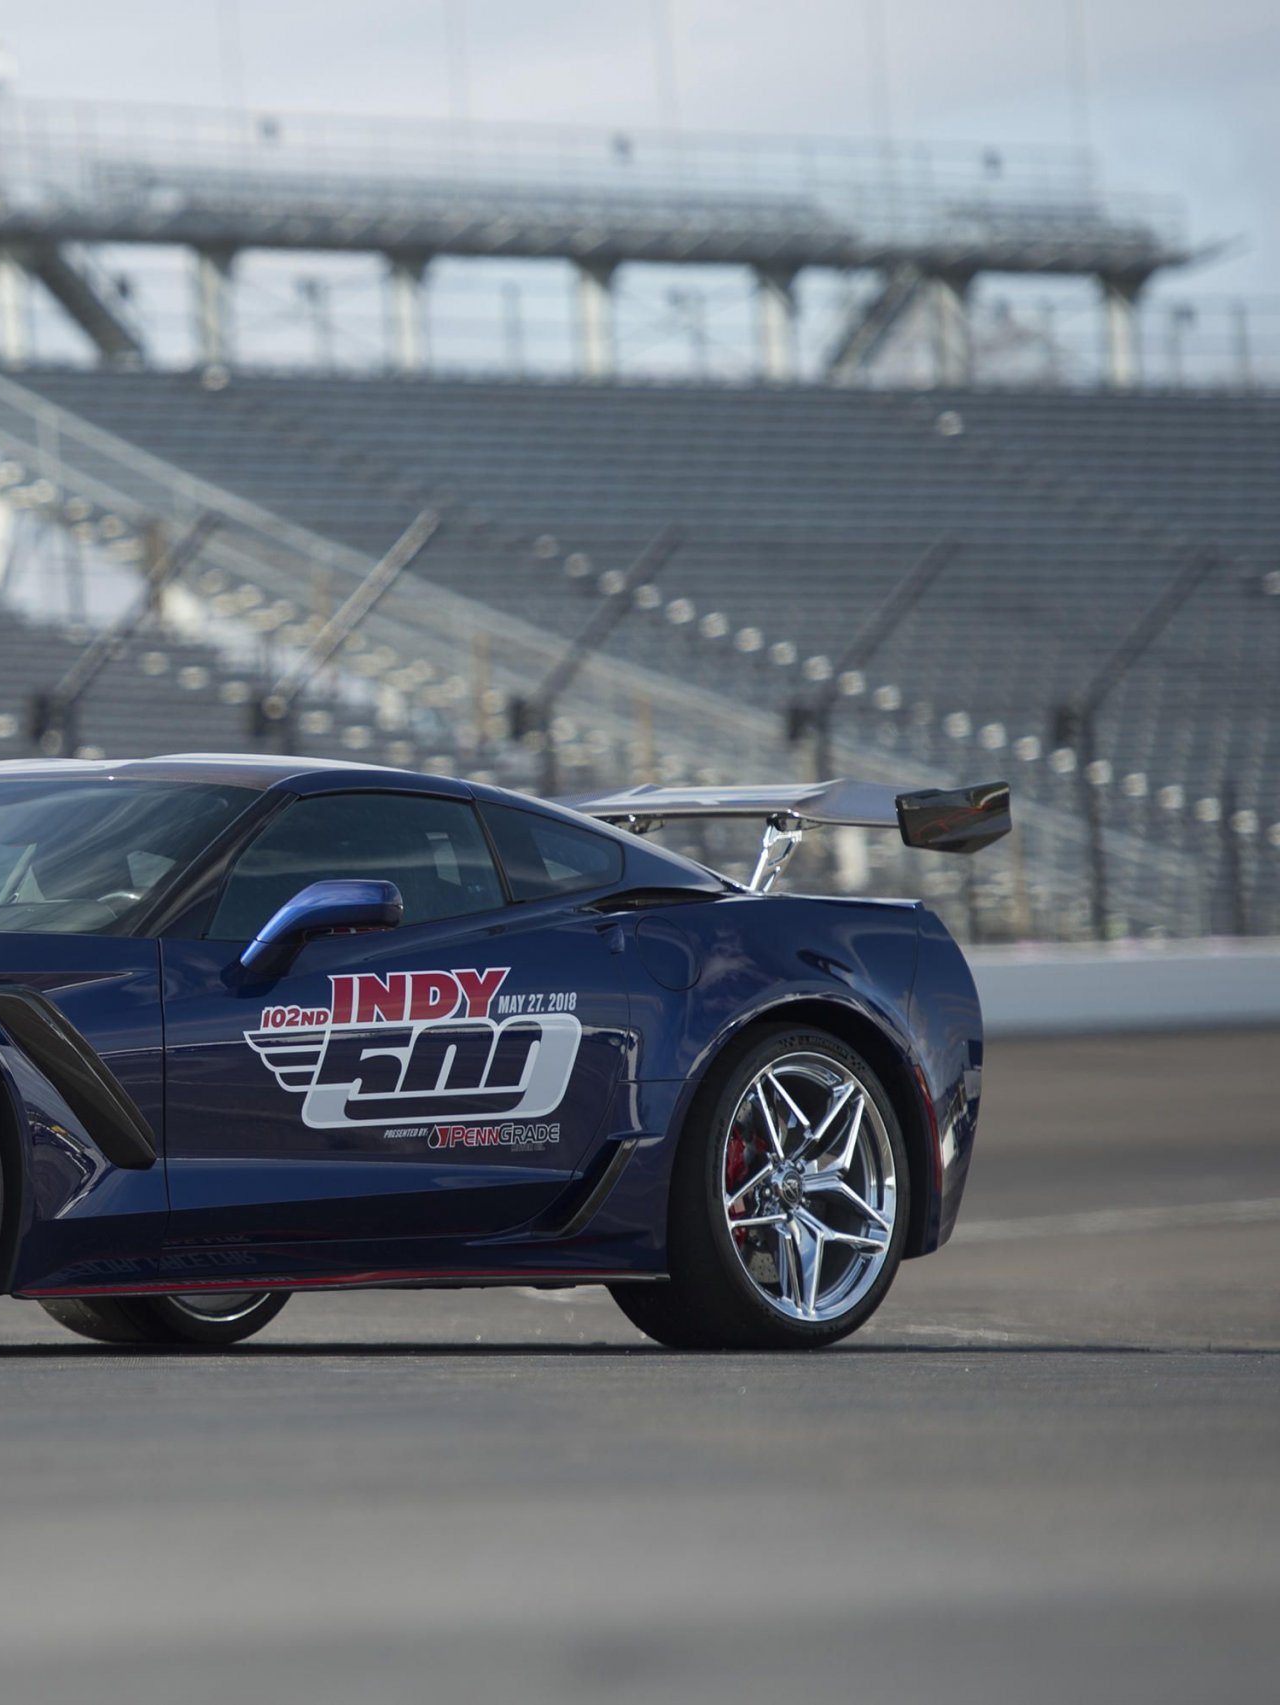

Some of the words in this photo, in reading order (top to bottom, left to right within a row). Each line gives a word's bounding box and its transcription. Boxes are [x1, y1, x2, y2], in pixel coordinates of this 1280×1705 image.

[328, 967, 511, 1024] INDY
[498, 995, 525, 1014] MAY
[548, 992, 577, 1012] 2018
[261, 1006, 330, 1029] 102ND
[301, 1013, 583, 1129] 500
[384, 1129, 418, 1139] PRESENTED
[449, 1122, 560, 1148] PENNGRADE
